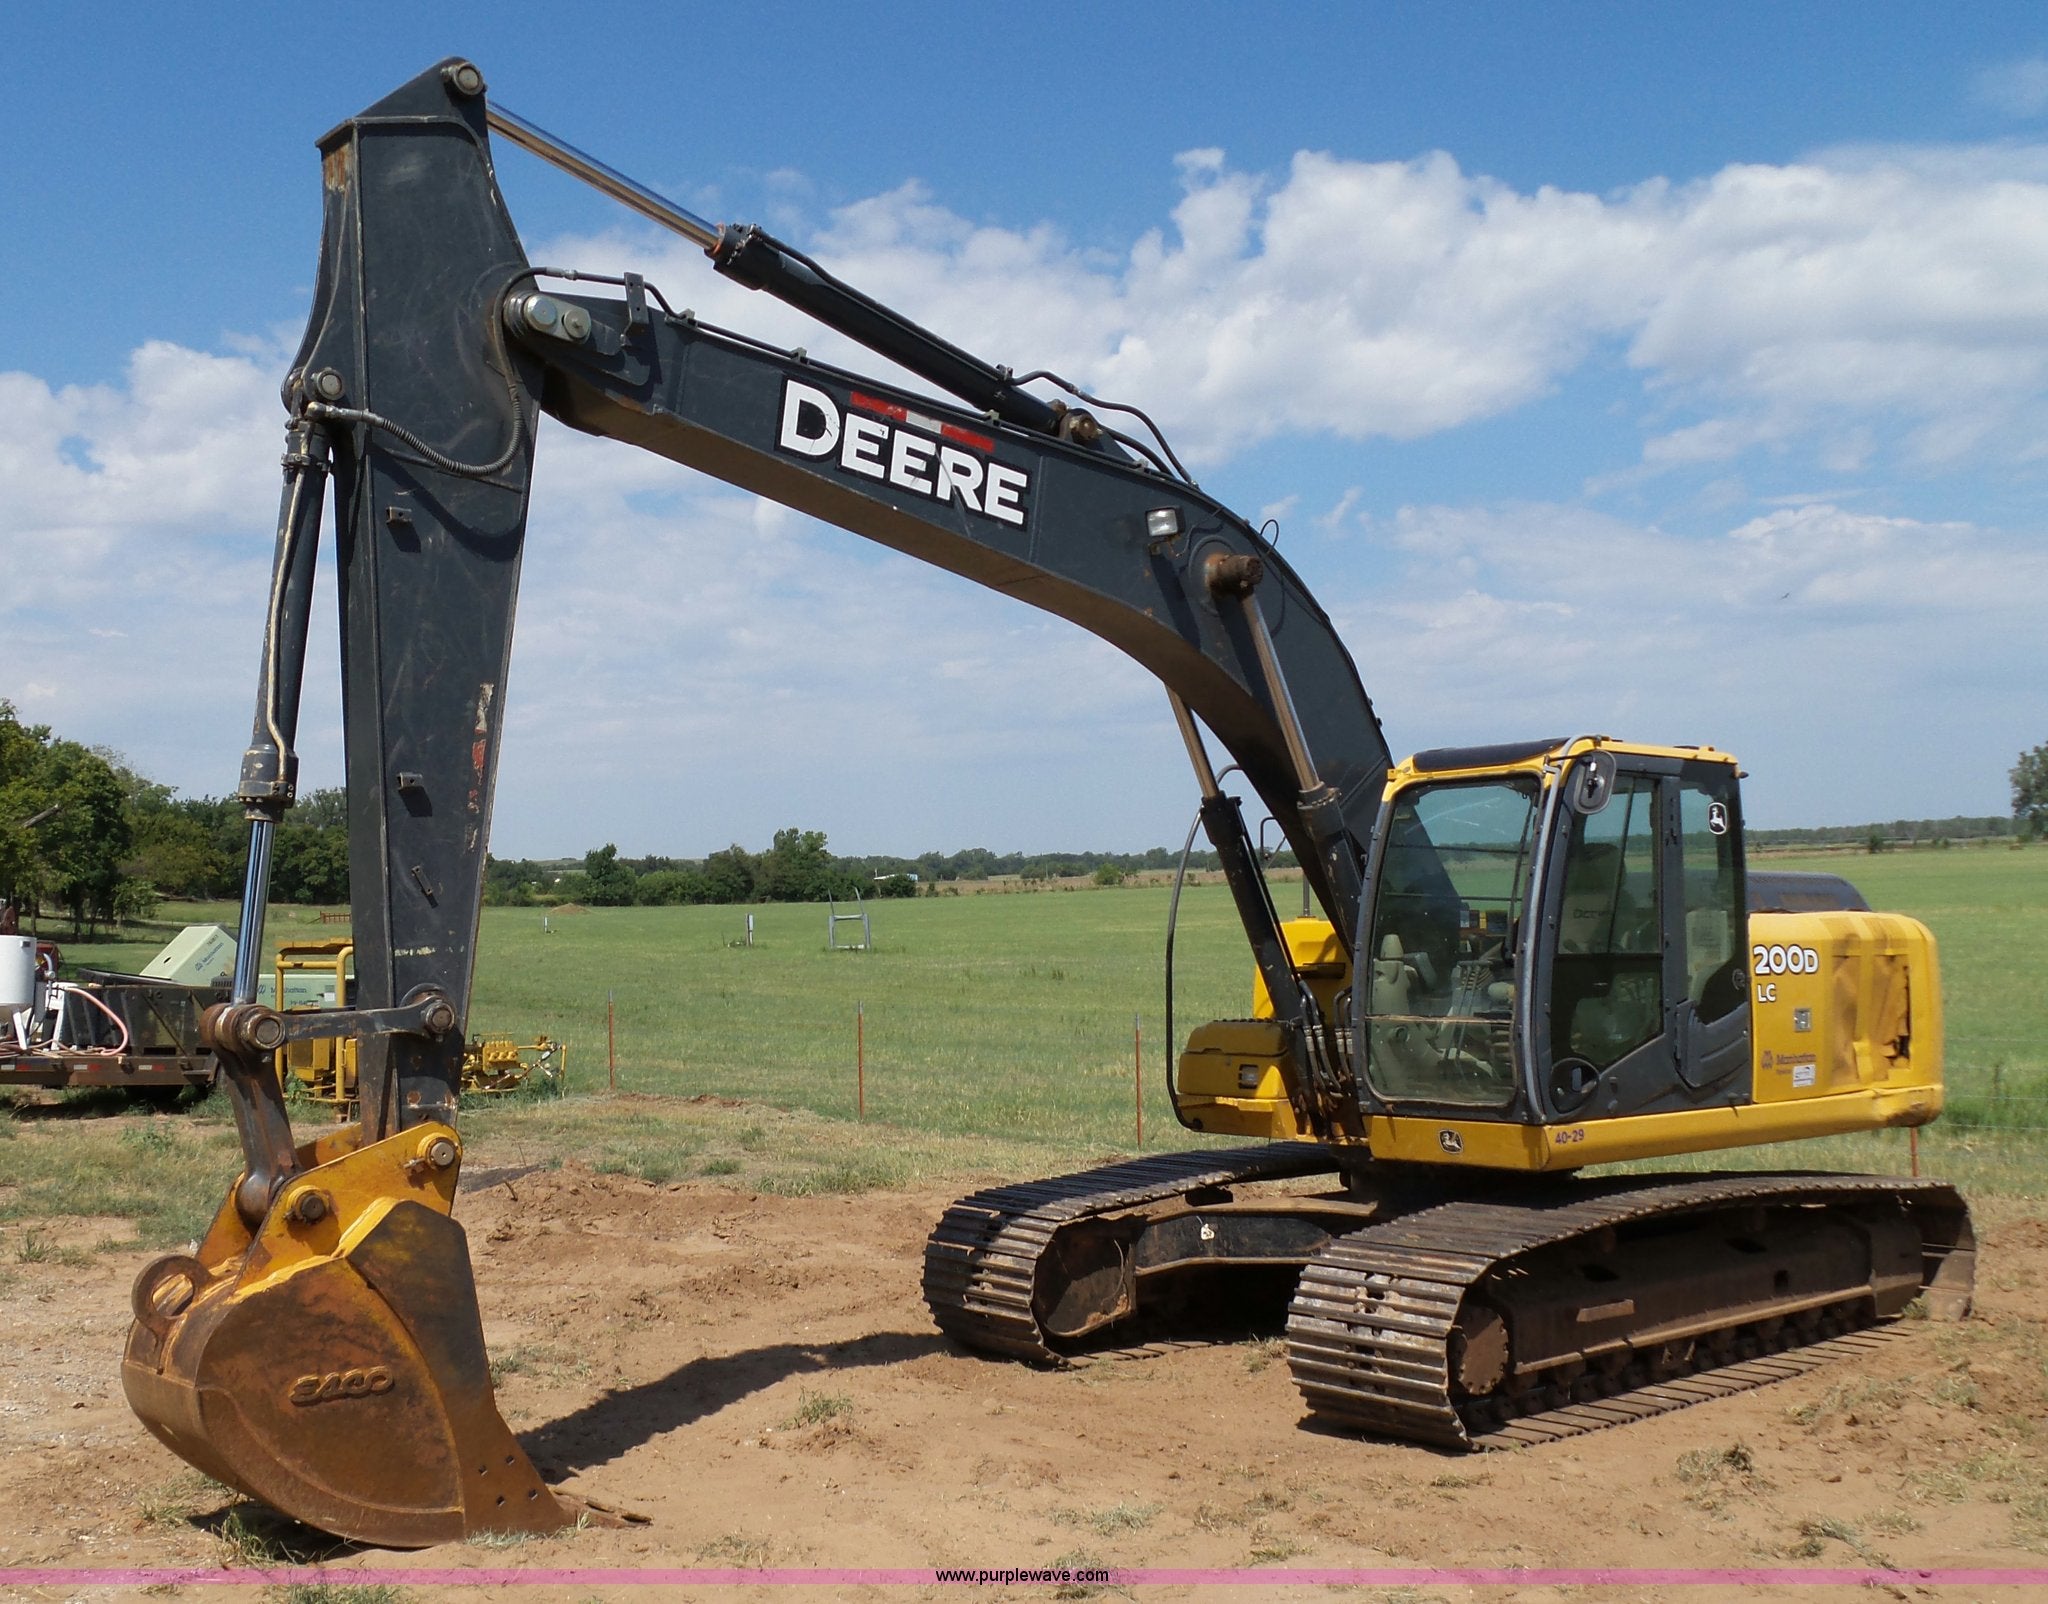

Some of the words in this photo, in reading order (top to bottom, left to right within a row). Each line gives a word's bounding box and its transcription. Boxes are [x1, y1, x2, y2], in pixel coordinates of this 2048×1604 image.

[780, 379, 1028, 525] DEERE
[1753, 945, 1819, 975] 200D
[1757, 983, 1776, 1003] LC
[1555, 1129, 1584, 1144] 40-29
